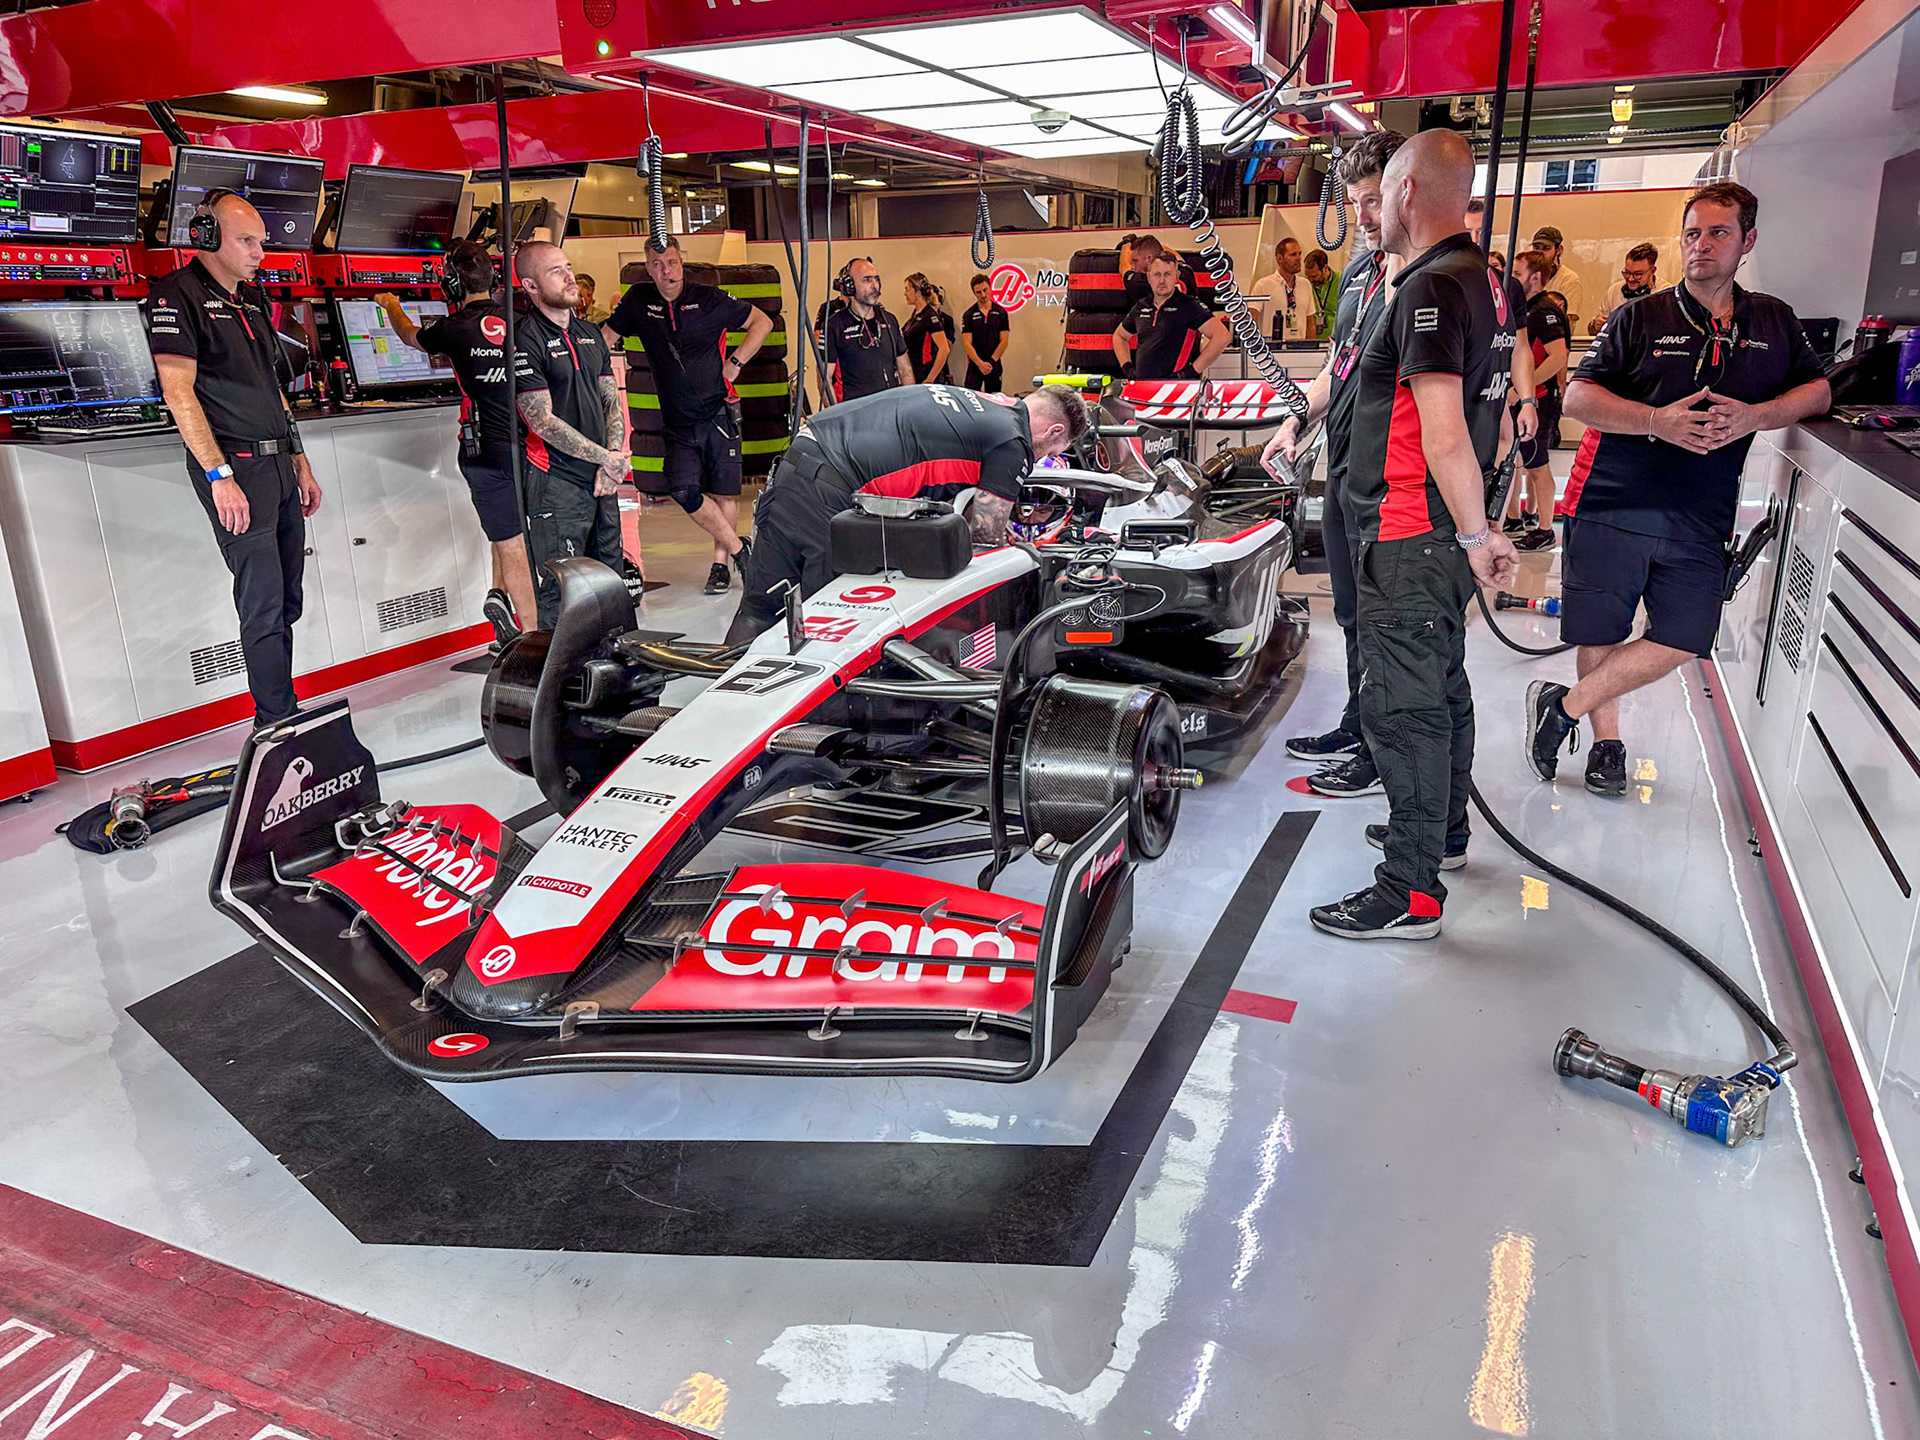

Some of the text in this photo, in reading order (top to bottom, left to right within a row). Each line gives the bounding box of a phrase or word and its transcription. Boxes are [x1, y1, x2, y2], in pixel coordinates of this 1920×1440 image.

[1655, 336, 1690, 344] HAAS
[470, 347, 504, 358] Money
[811, 601, 890, 612] MoneyGram
[707, 657, 826, 697] 27
[1180, 713, 1206, 733] els
[641, 754, 712, 769] HAAS
[262, 765, 364, 827] OAKBERRY
[603, 787, 677, 807] PIRELLI
[555, 834, 629, 853] MARKETS
[563, 824, 639, 845] HANTEC
[357, 827, 495, 927] Money
[532, 877, 590, 897] CHIPOTLE
[702, 884, 1016, 983] Gram
